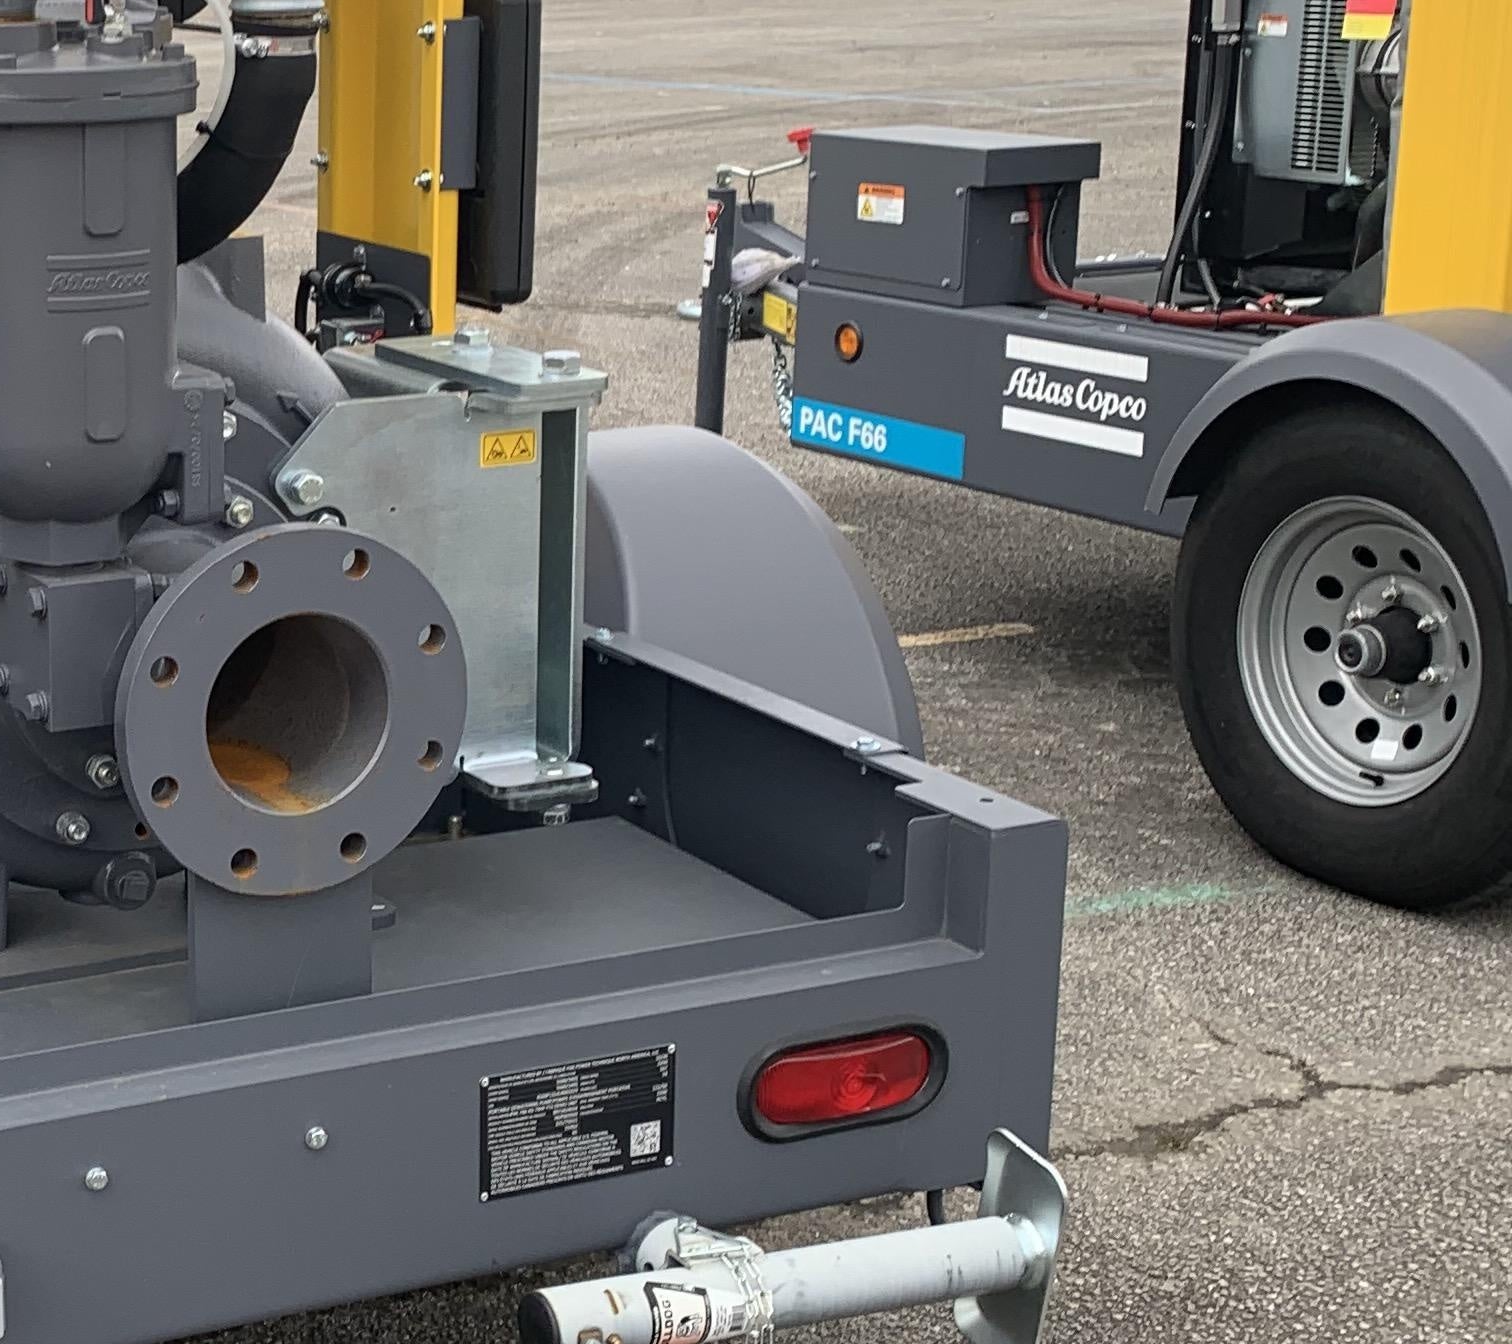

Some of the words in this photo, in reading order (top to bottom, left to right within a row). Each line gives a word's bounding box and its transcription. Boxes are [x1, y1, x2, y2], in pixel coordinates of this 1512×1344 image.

[1002, 366, 1074, 409] Atlas
[1075, 378, 1148, 423] Copco
[799, 405, 844, 443] PAC
[846, 419, 888, 454] F66
